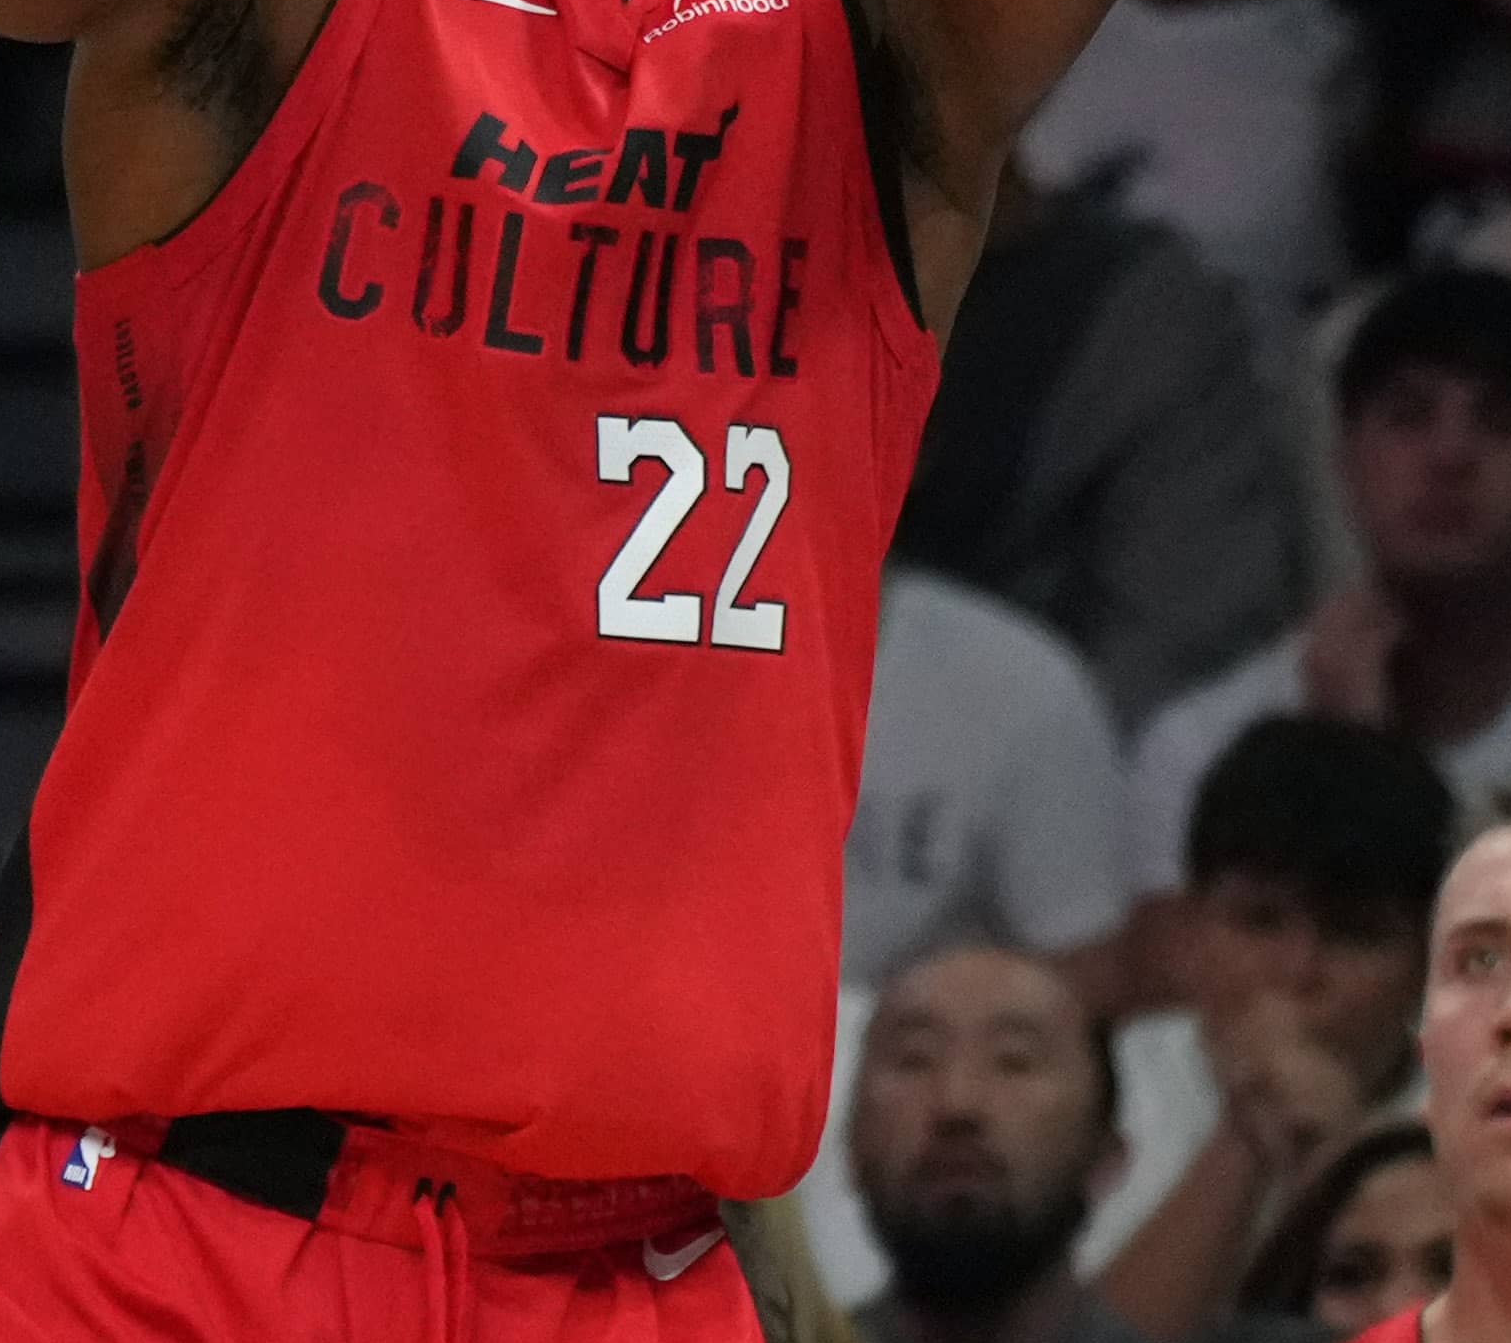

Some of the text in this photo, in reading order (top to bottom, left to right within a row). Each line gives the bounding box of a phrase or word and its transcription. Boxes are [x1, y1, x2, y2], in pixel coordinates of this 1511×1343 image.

[452, 102, 739, 212] HEAT
[318, 180, 808, 378] CULTURE
[595, 415, 791, 655] 22
